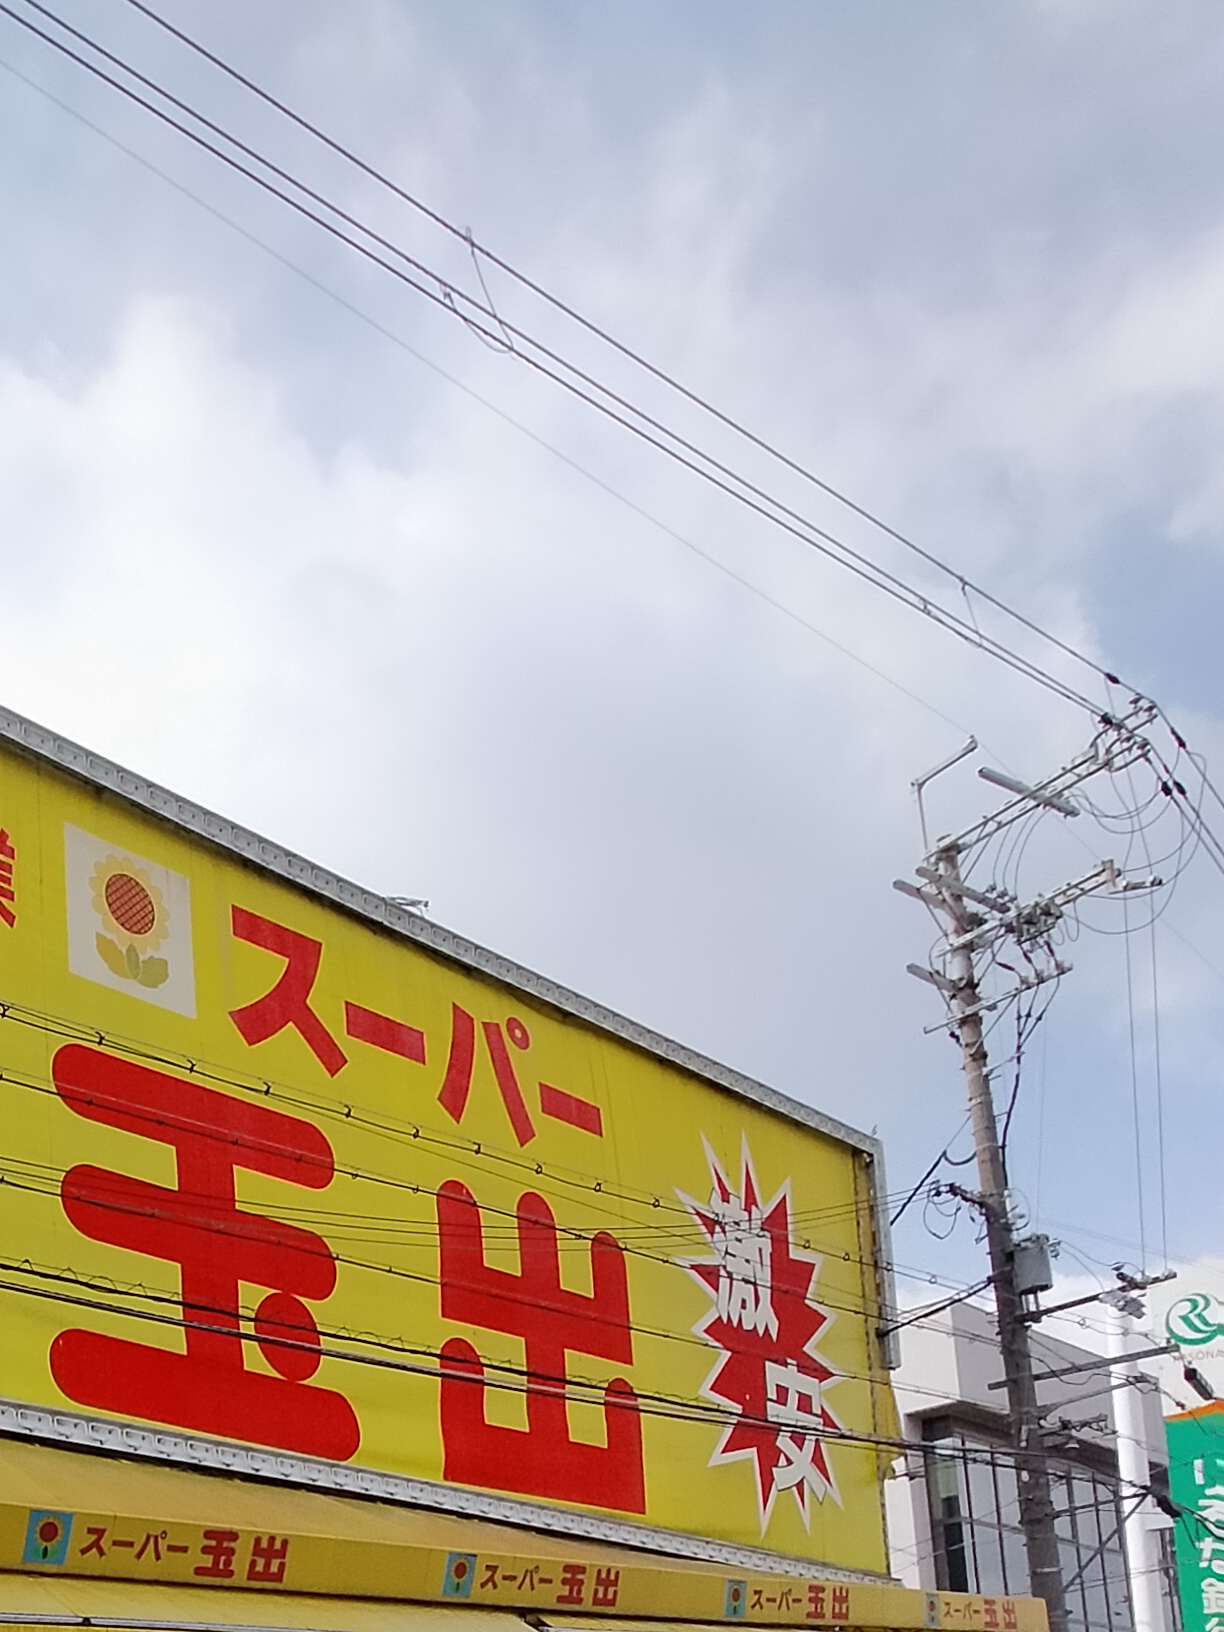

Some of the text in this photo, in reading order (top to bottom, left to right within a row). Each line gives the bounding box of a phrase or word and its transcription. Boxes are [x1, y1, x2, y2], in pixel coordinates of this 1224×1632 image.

[227, 903, 605, 1149] スーパー
[49, 1042, 647, 1515] 玉出
[708, 1187, 827, 1505] 激安
